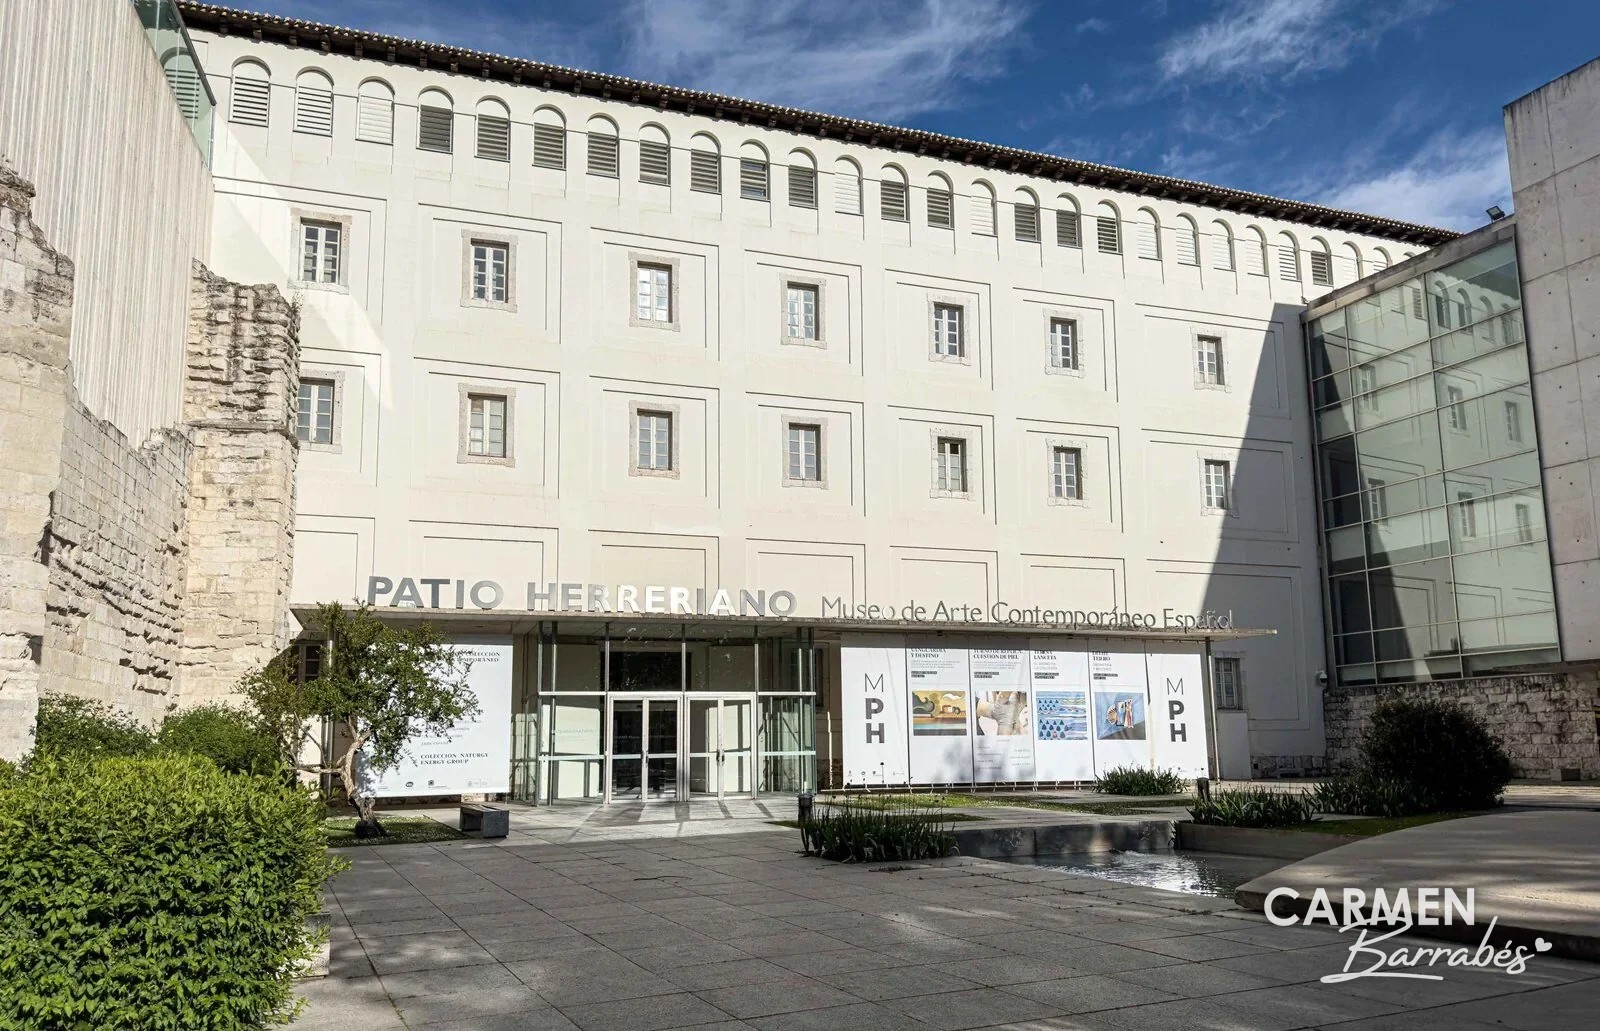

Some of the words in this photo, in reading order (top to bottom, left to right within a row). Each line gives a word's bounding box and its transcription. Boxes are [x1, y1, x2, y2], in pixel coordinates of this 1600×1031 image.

[367, 576, 504, 610] PATIO
[527, 582, 797, 617] HERRERIANO
[821, 595, 895, 619] Museo
[901, 599, 926, 621] de
[933, 600, 982, 622] Arte
[991, 601, 1156, 631] Contemporáneo
[1163, 608, 1233, 634] Español
